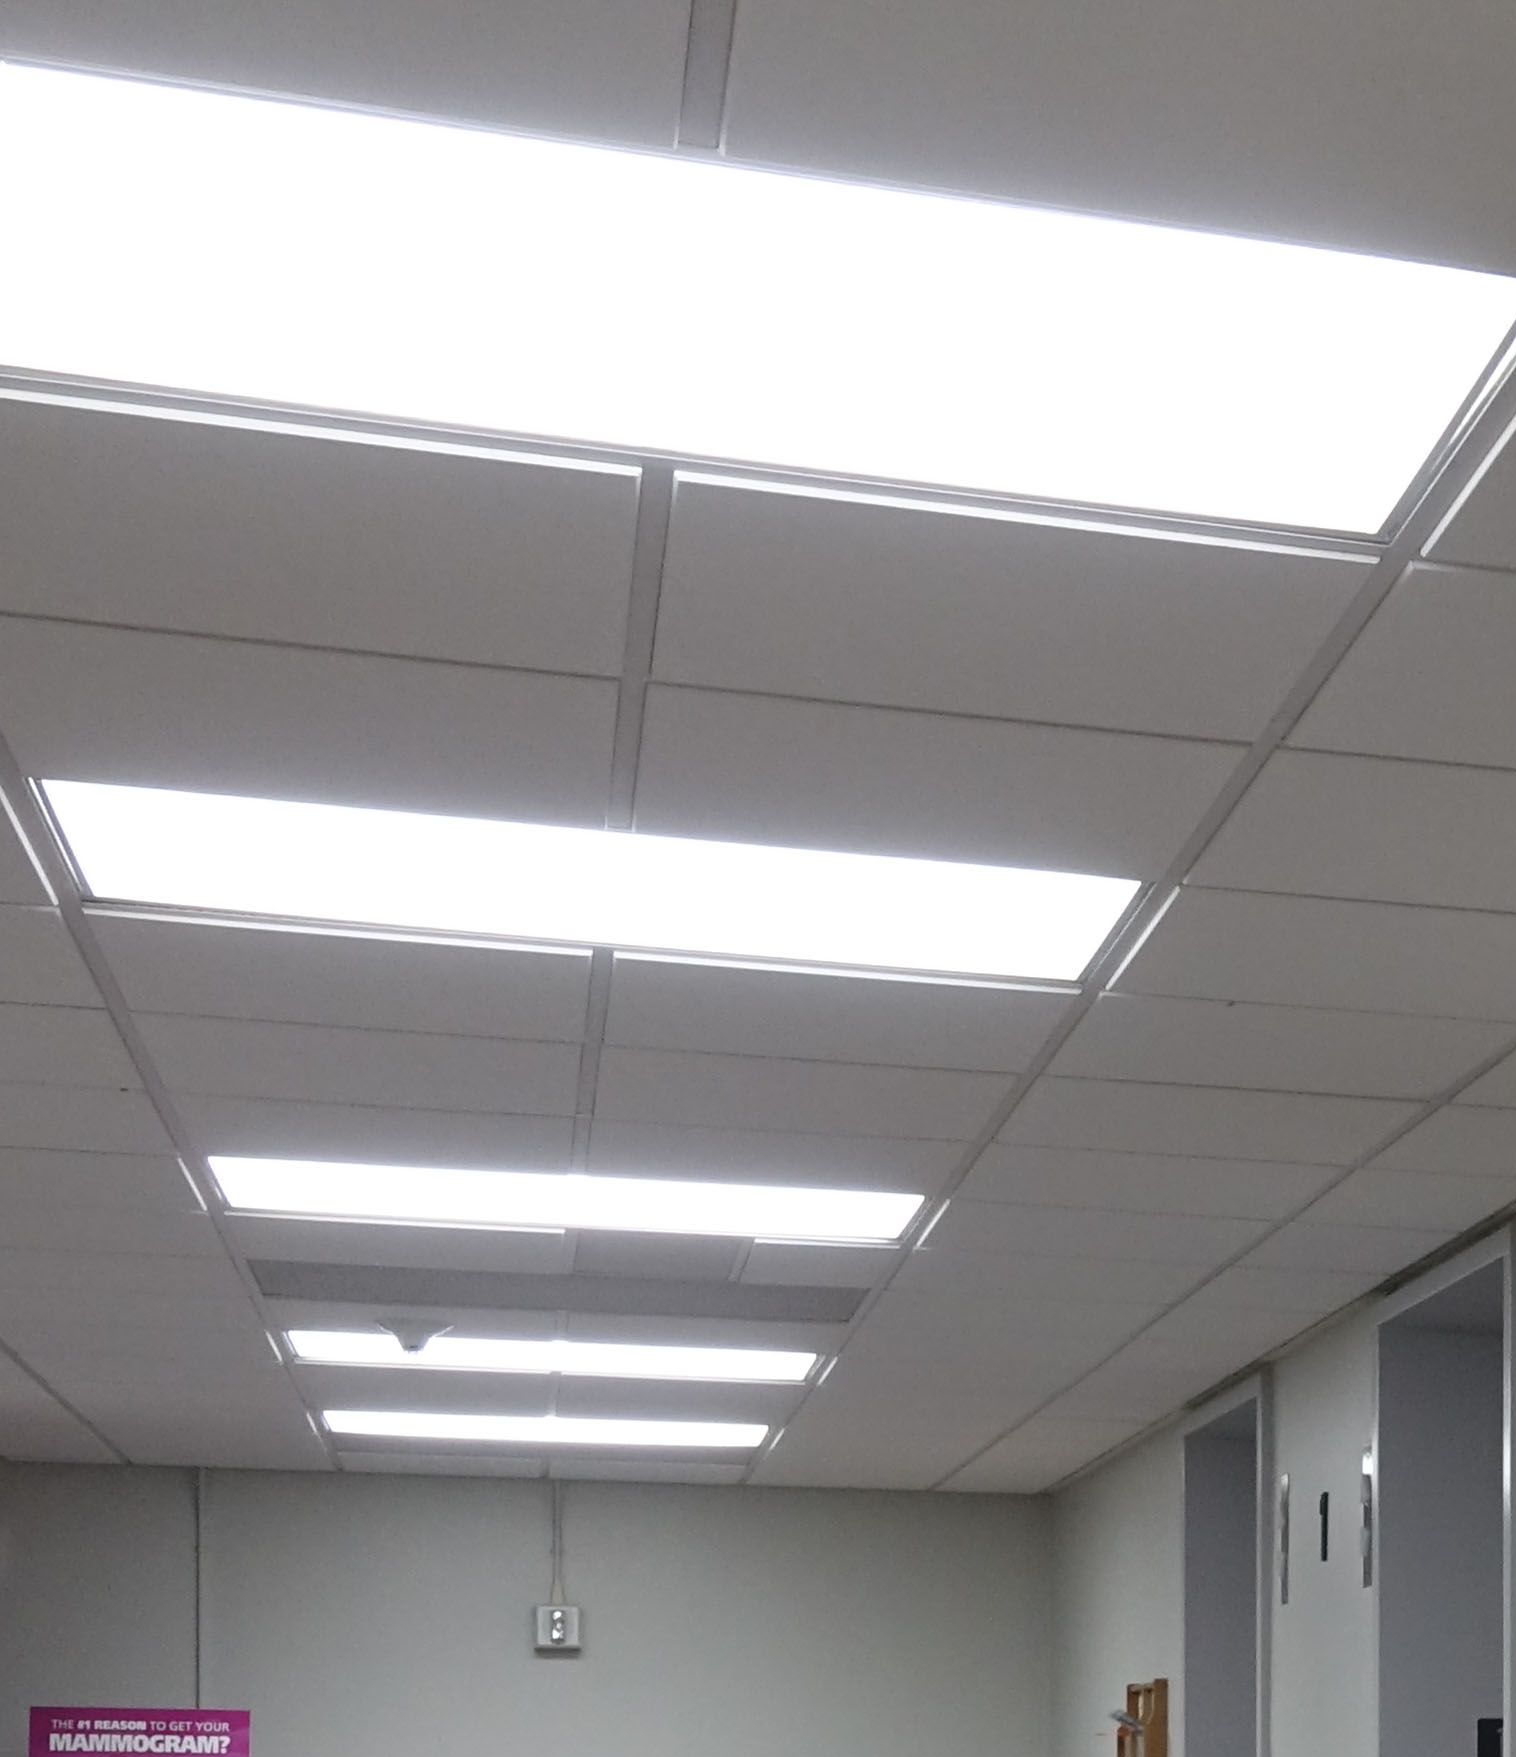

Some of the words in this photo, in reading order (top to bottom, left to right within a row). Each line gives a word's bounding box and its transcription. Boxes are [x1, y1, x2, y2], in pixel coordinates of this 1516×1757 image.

[51, 1719, 73, 1730] THE
[94, 1721, 147, 1730] REASON
[150, 1722, 165, 1731] TO
[169, 1722, 192, 1731] GET
[195, 1722, 230, 1732] YOUR
[49, 1733, 231, 1754] MAMMOGRAM?
